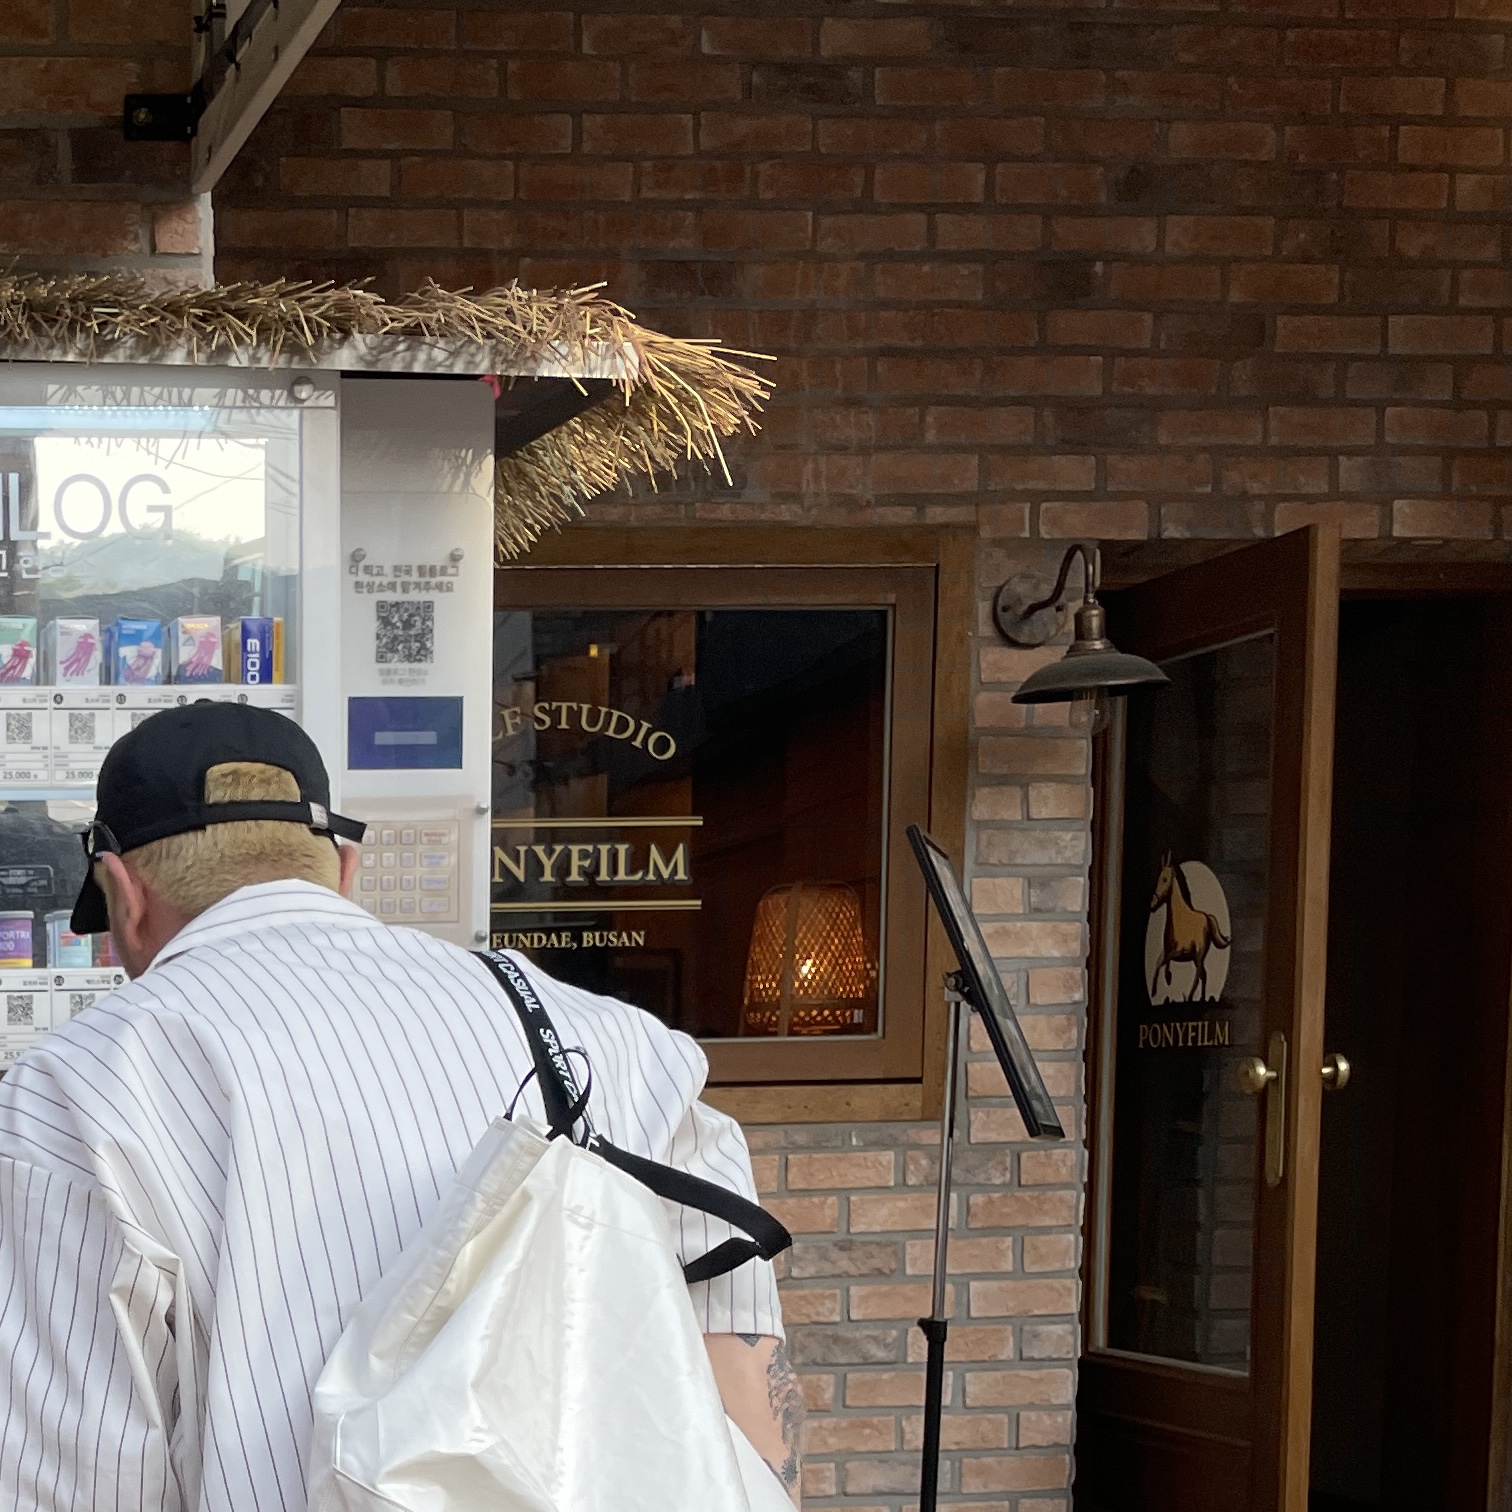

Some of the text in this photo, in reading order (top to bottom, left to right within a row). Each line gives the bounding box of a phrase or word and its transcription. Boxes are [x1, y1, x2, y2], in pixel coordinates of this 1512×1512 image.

[354, 580, 455, 595] 현상소에 맡겨주세요
[417, 564, 460, 579] 필름로그
[246, 638, 261, 685] E100
[533, 701, 676, 761] STUDIO
[491, 842, 688, 883] NYFILM
[492, 930, 645, 950] EUNDAE, BUSAN
[498, 958, 540, 1013] CASUAL
[1139, 1020, 1230, 1049] PONYFILM
